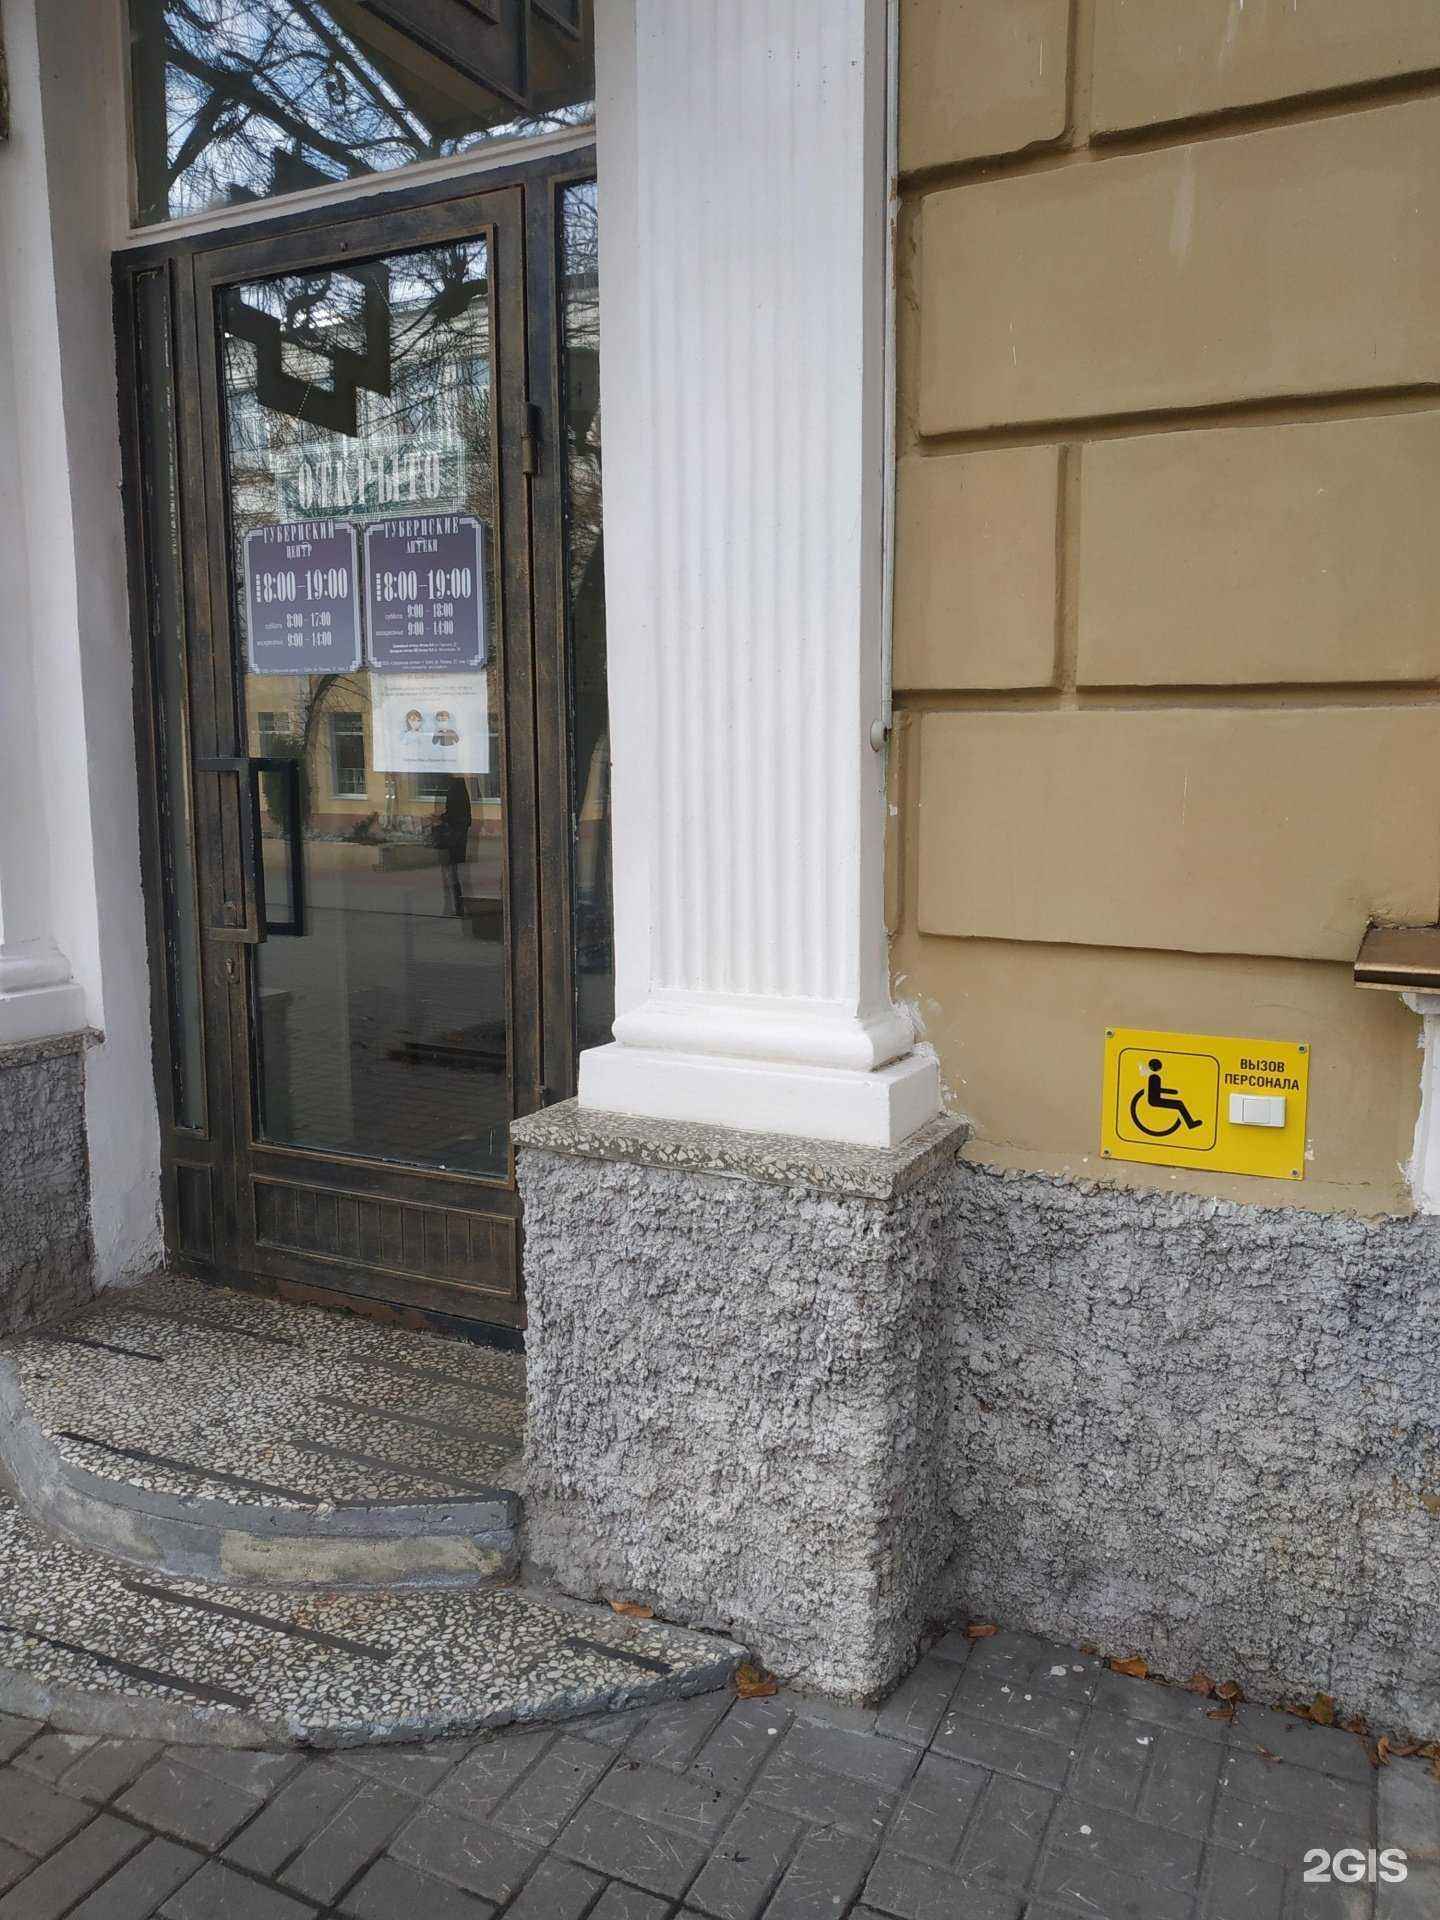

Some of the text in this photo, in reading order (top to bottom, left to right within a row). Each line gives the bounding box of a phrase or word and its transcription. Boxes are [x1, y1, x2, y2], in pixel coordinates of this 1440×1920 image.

[298, 451, 441, 510] ОТКРЫТО
[384, 516, 459, 538] ГУБЕРНСКИЕ
[286, 542, 313, 559] ЦЕНТР
[406, 537, 438, 553] АПТЕКИ
[433, 602, 453, 618] 18:00
[311, 611, 331, 627] 17:00
[408, 621, 424, 636] 9:00
[287, 632, 303, 648] 9:00
[1240, 1058, 1285, 1073] ВЫЗОВ
[1224, 1073, 1300, 1091] ПЕРСОНАЛА
